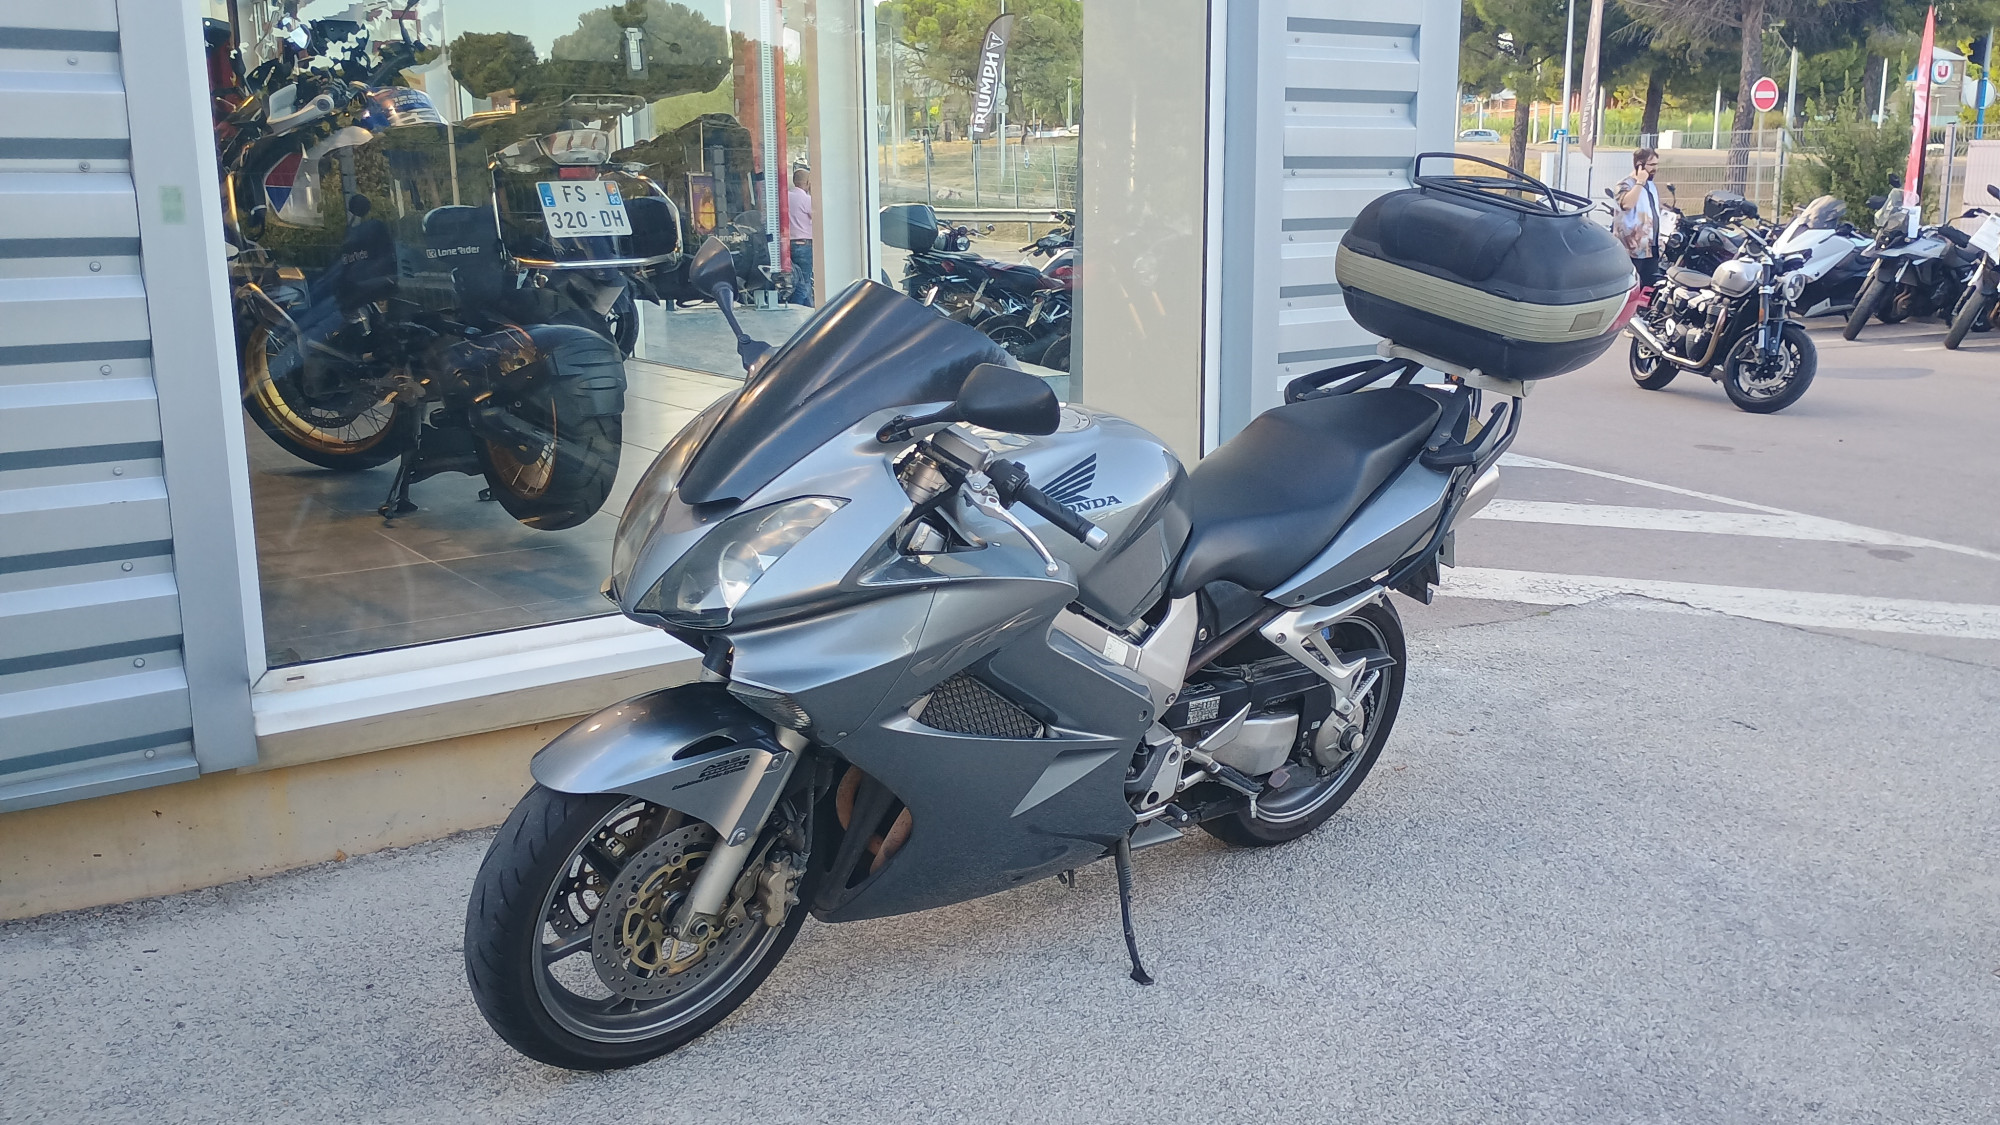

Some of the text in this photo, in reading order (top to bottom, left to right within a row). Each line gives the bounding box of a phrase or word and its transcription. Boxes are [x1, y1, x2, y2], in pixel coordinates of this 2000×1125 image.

[1937, 65, 1949, 78] U
[974, 52, 1000, 133] TRIUMPH
[545, 197, 555, 206] F
[438, 247, 458, 257] Lone
[1064, 495, 1122, 513] ONDA
